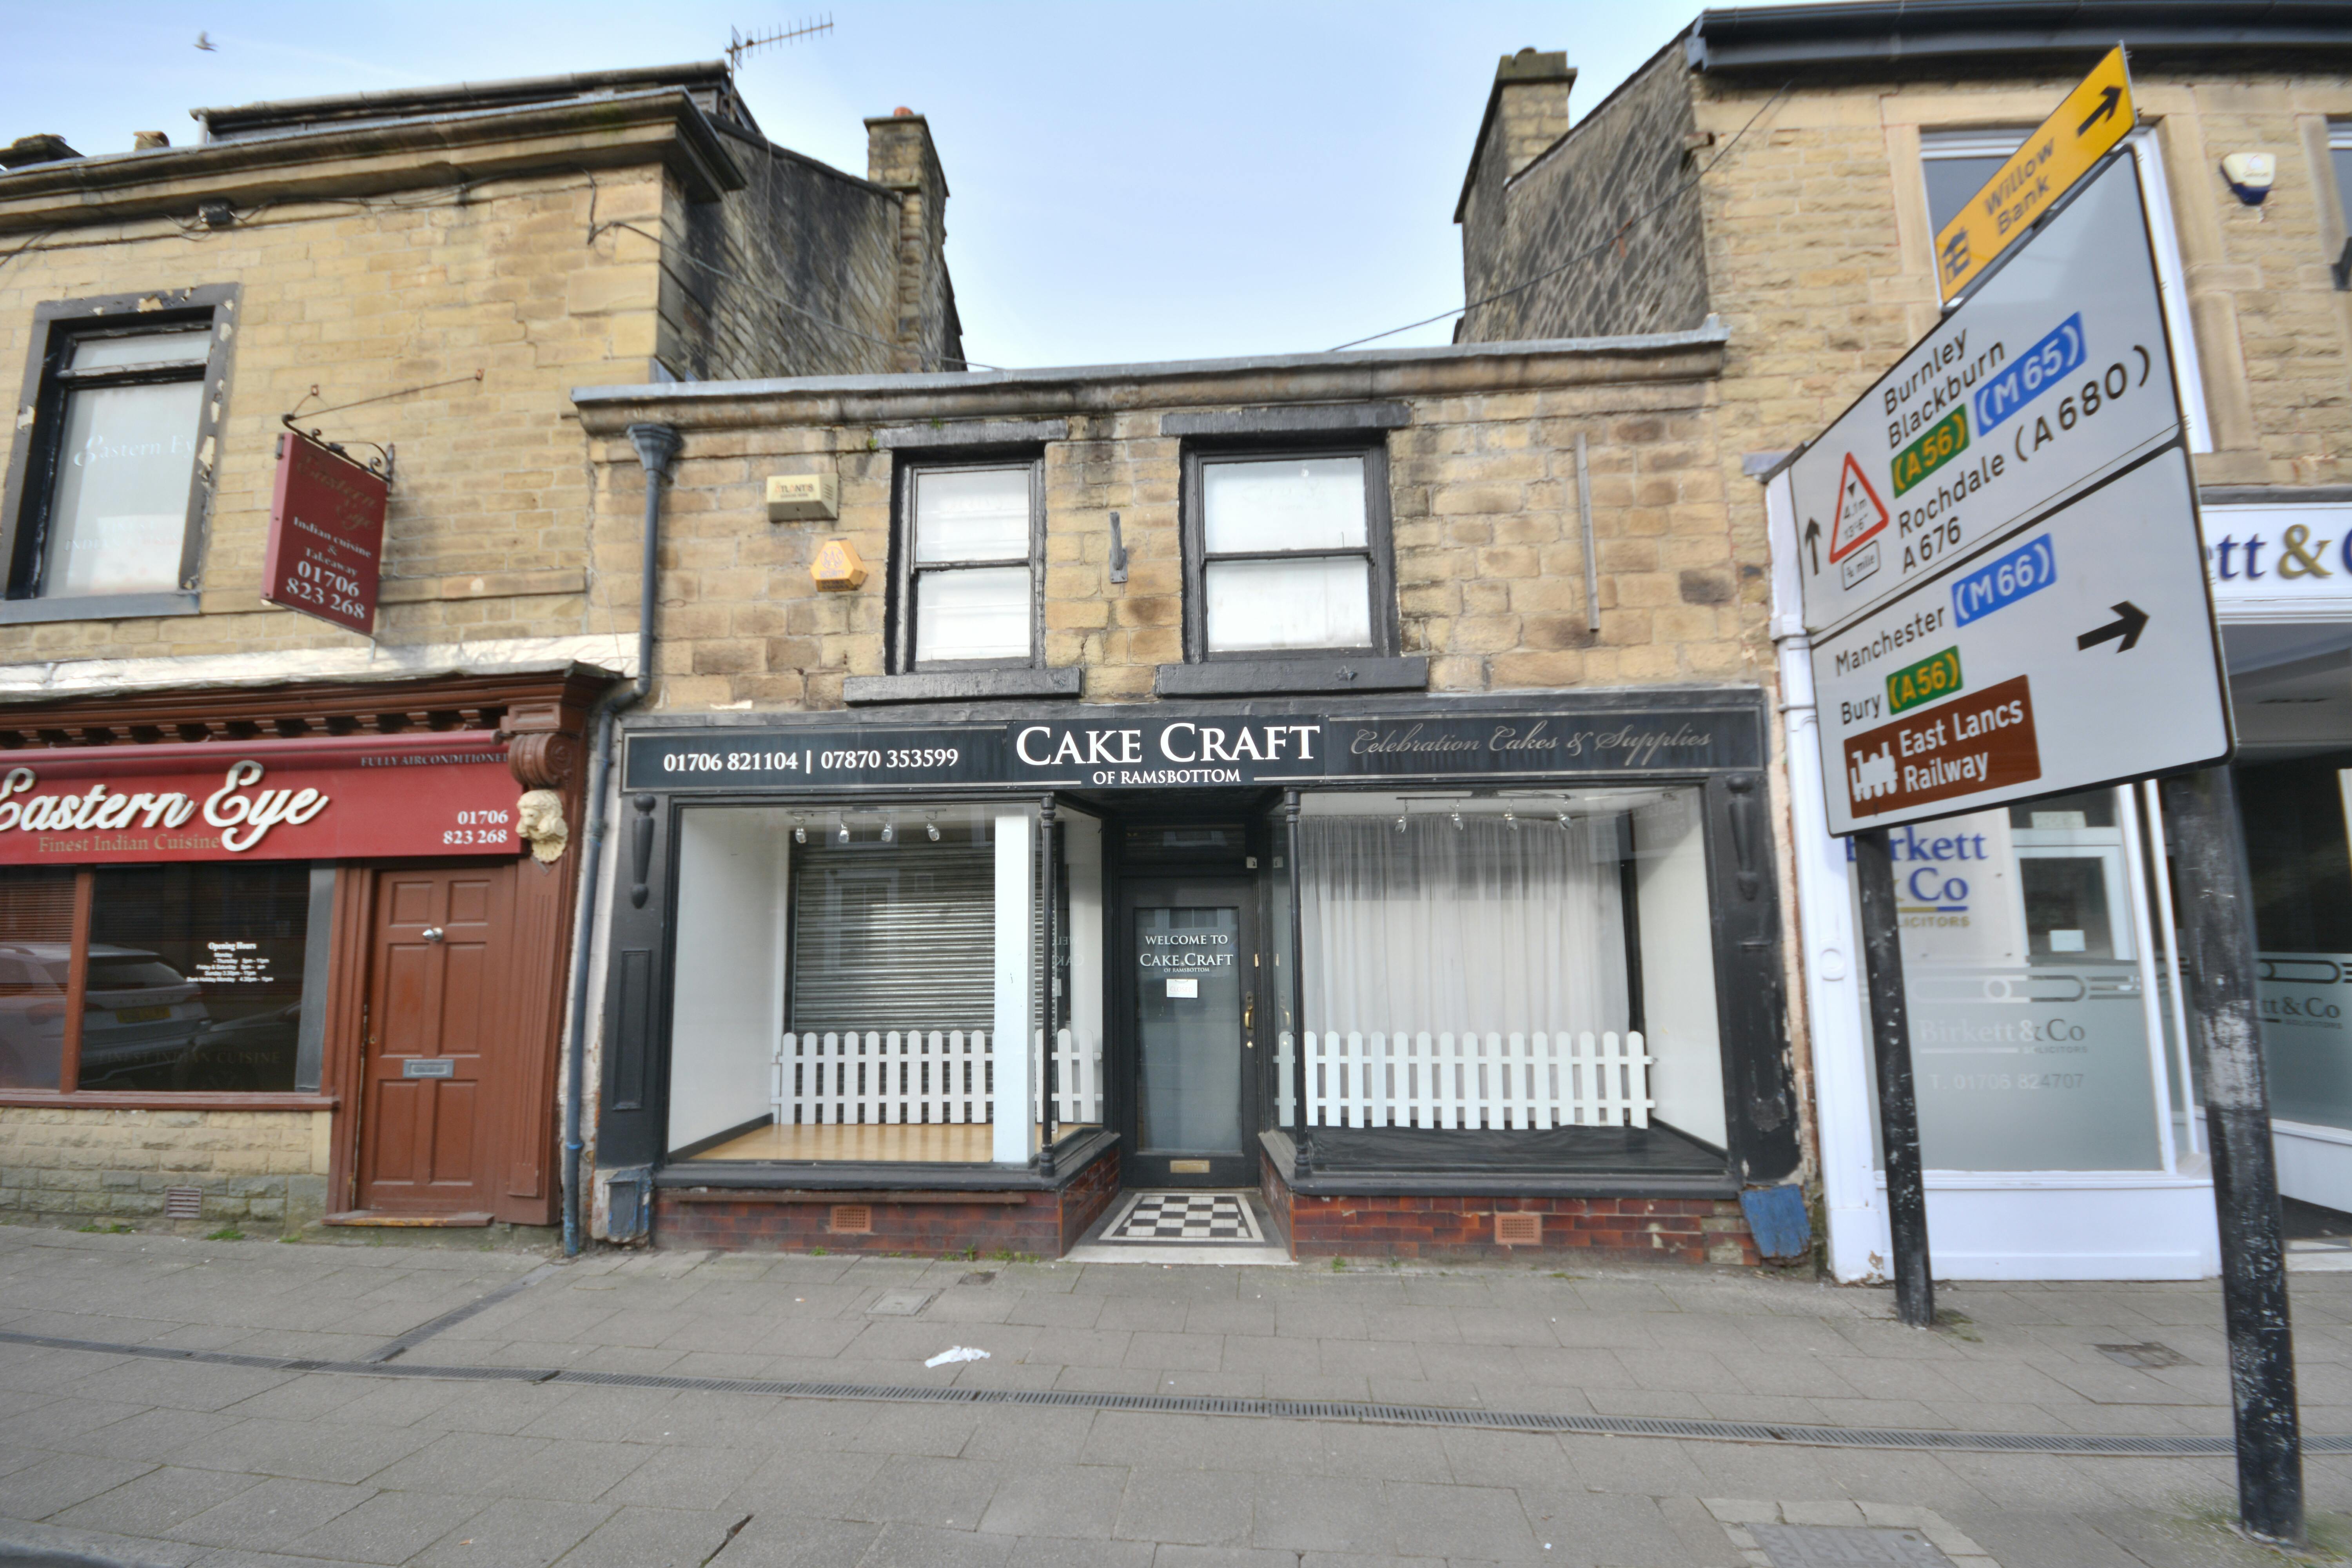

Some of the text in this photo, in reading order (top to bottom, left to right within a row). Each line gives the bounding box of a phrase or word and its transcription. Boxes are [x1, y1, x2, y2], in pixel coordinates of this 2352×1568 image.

[1983, 137, 2055, 216] Willow
[1998, 175, 2051, 236] Bank
[1884, 328, 1967, 417] Burnley
[1889, 341, 2005, 449] Blackburn
[1899, 452, 2005, 539] Rochdale
[294, 517, 371, 559] Indian cuisine
[327, 544, 337, 555] &
[2278, 524, 2334, 579] &
[305, 547, 358, 575] Takeaway
[1857, 554, 1875, 573] mile
[298, 561, 359, 597] 01706
[286, 577, 365, 619] 823 268
[1835, 606, 1946, 677] Manchester
[1840, 692, 1881, 725] Bury
[1016, 722, 1320, 766] CAKE CRAFT
[1351, 720, 1712, 766] Celebration Cakes & Supplies
[1899, 699, 2024, 758] East Lancs
[361, 756, 398, 766] FULLY
[663, 748, 958, 772] 01706 821104 07870 353599
[1093, 769, 1241, 784] OF RAMSBOTTOM
[1904, 750, 1989, 793] Railway
[0, 760, 329, 851] Eastern Eye
[457, 810, 508, 824] 01706
[39, 834, 220, 852] Finest Indian Cuisine
[443, 829, 508, 844] 823 268
[1909, 867, 1969, 902] Co
[208, 942, 235, 951] Opening
[1145, 935, 1228, 945] WELCOME TO
[1140, 953, 1234, 966] CAKE CRAFT
[2306, 997, 2341, 1018] Co
[1920, 1018, 2085, 1042] Birkett & Co
[1953, 1074, 2011, 1090] 01706
[2018, 1074, 2083, 1089] 824707
